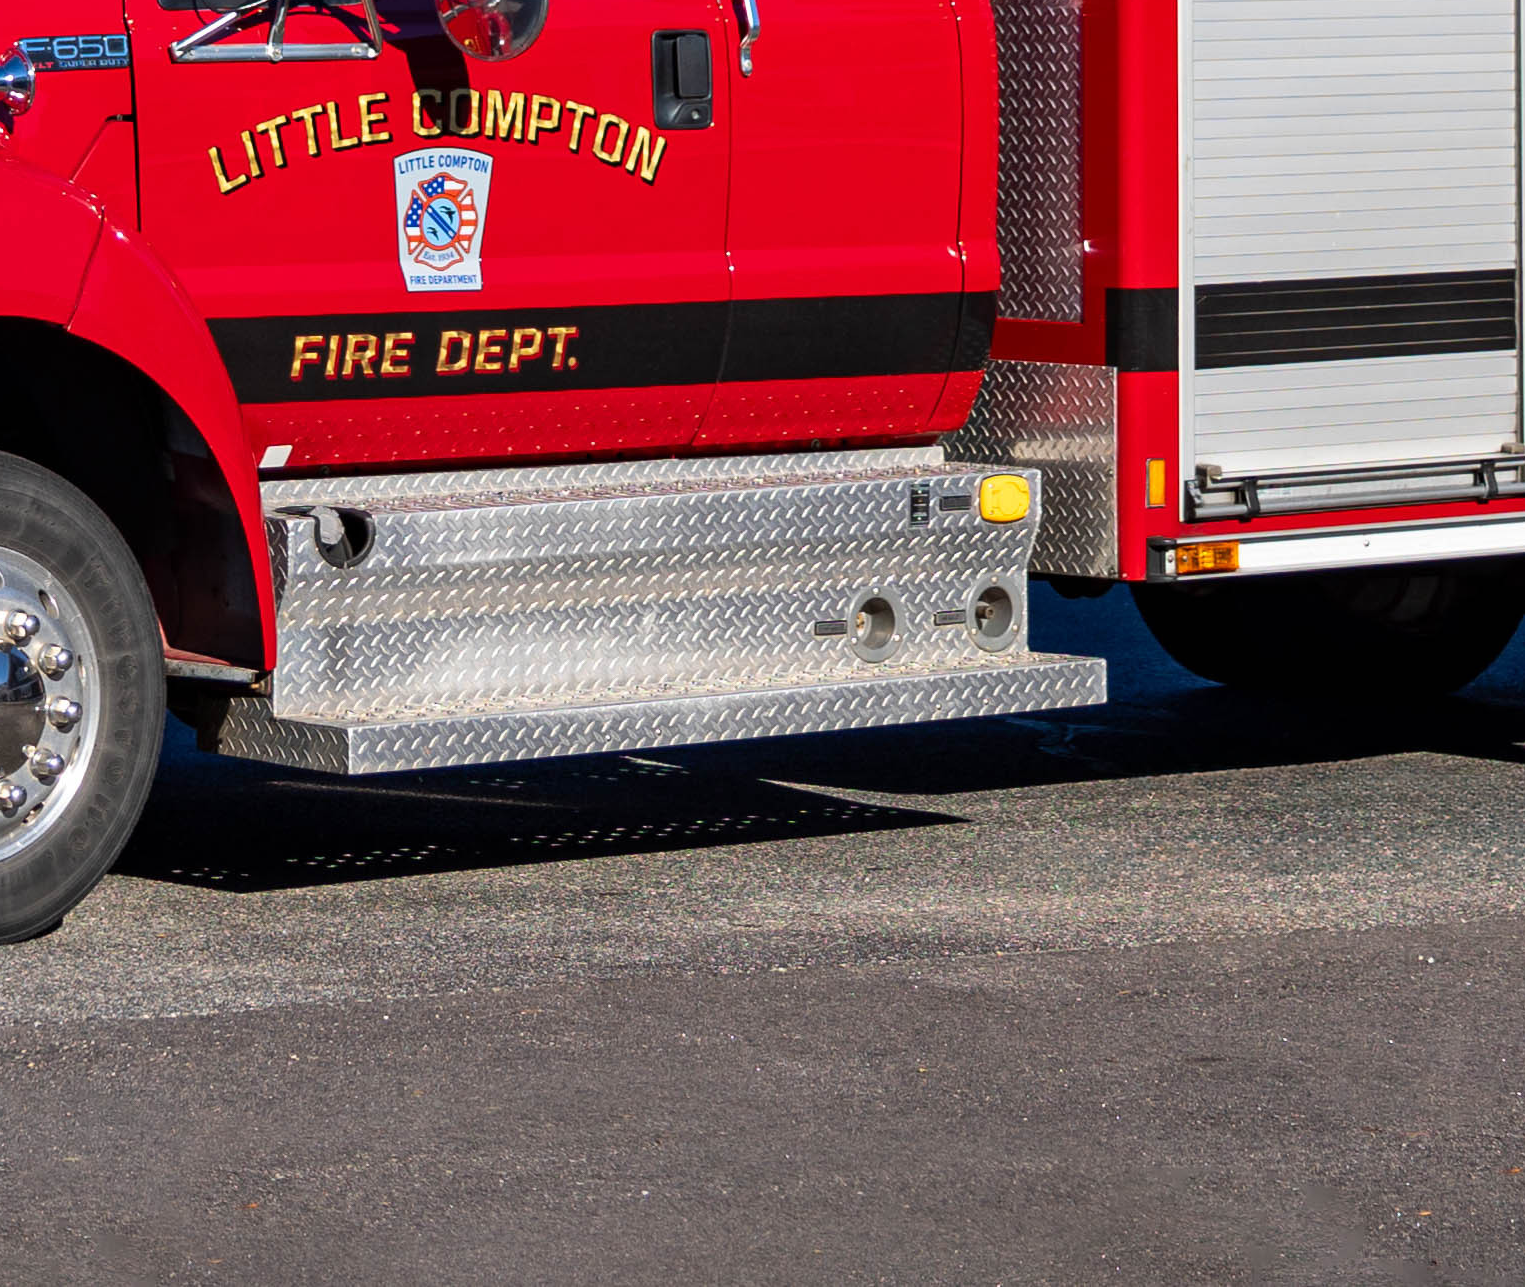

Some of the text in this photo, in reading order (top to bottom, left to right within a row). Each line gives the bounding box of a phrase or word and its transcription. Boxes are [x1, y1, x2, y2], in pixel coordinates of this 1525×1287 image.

[59, 59, 97, 68] SUPER
[100, 58, 129, 66] DUTY
[207, 88, 667, 194] LITTLE COMPTON
[398, 154, 489, 175] LITTLE COMPTON
[410, 274, 477, 285] FIRE DEPARTMENT
[290, 325, 579, 381] FIRE DEPT.
